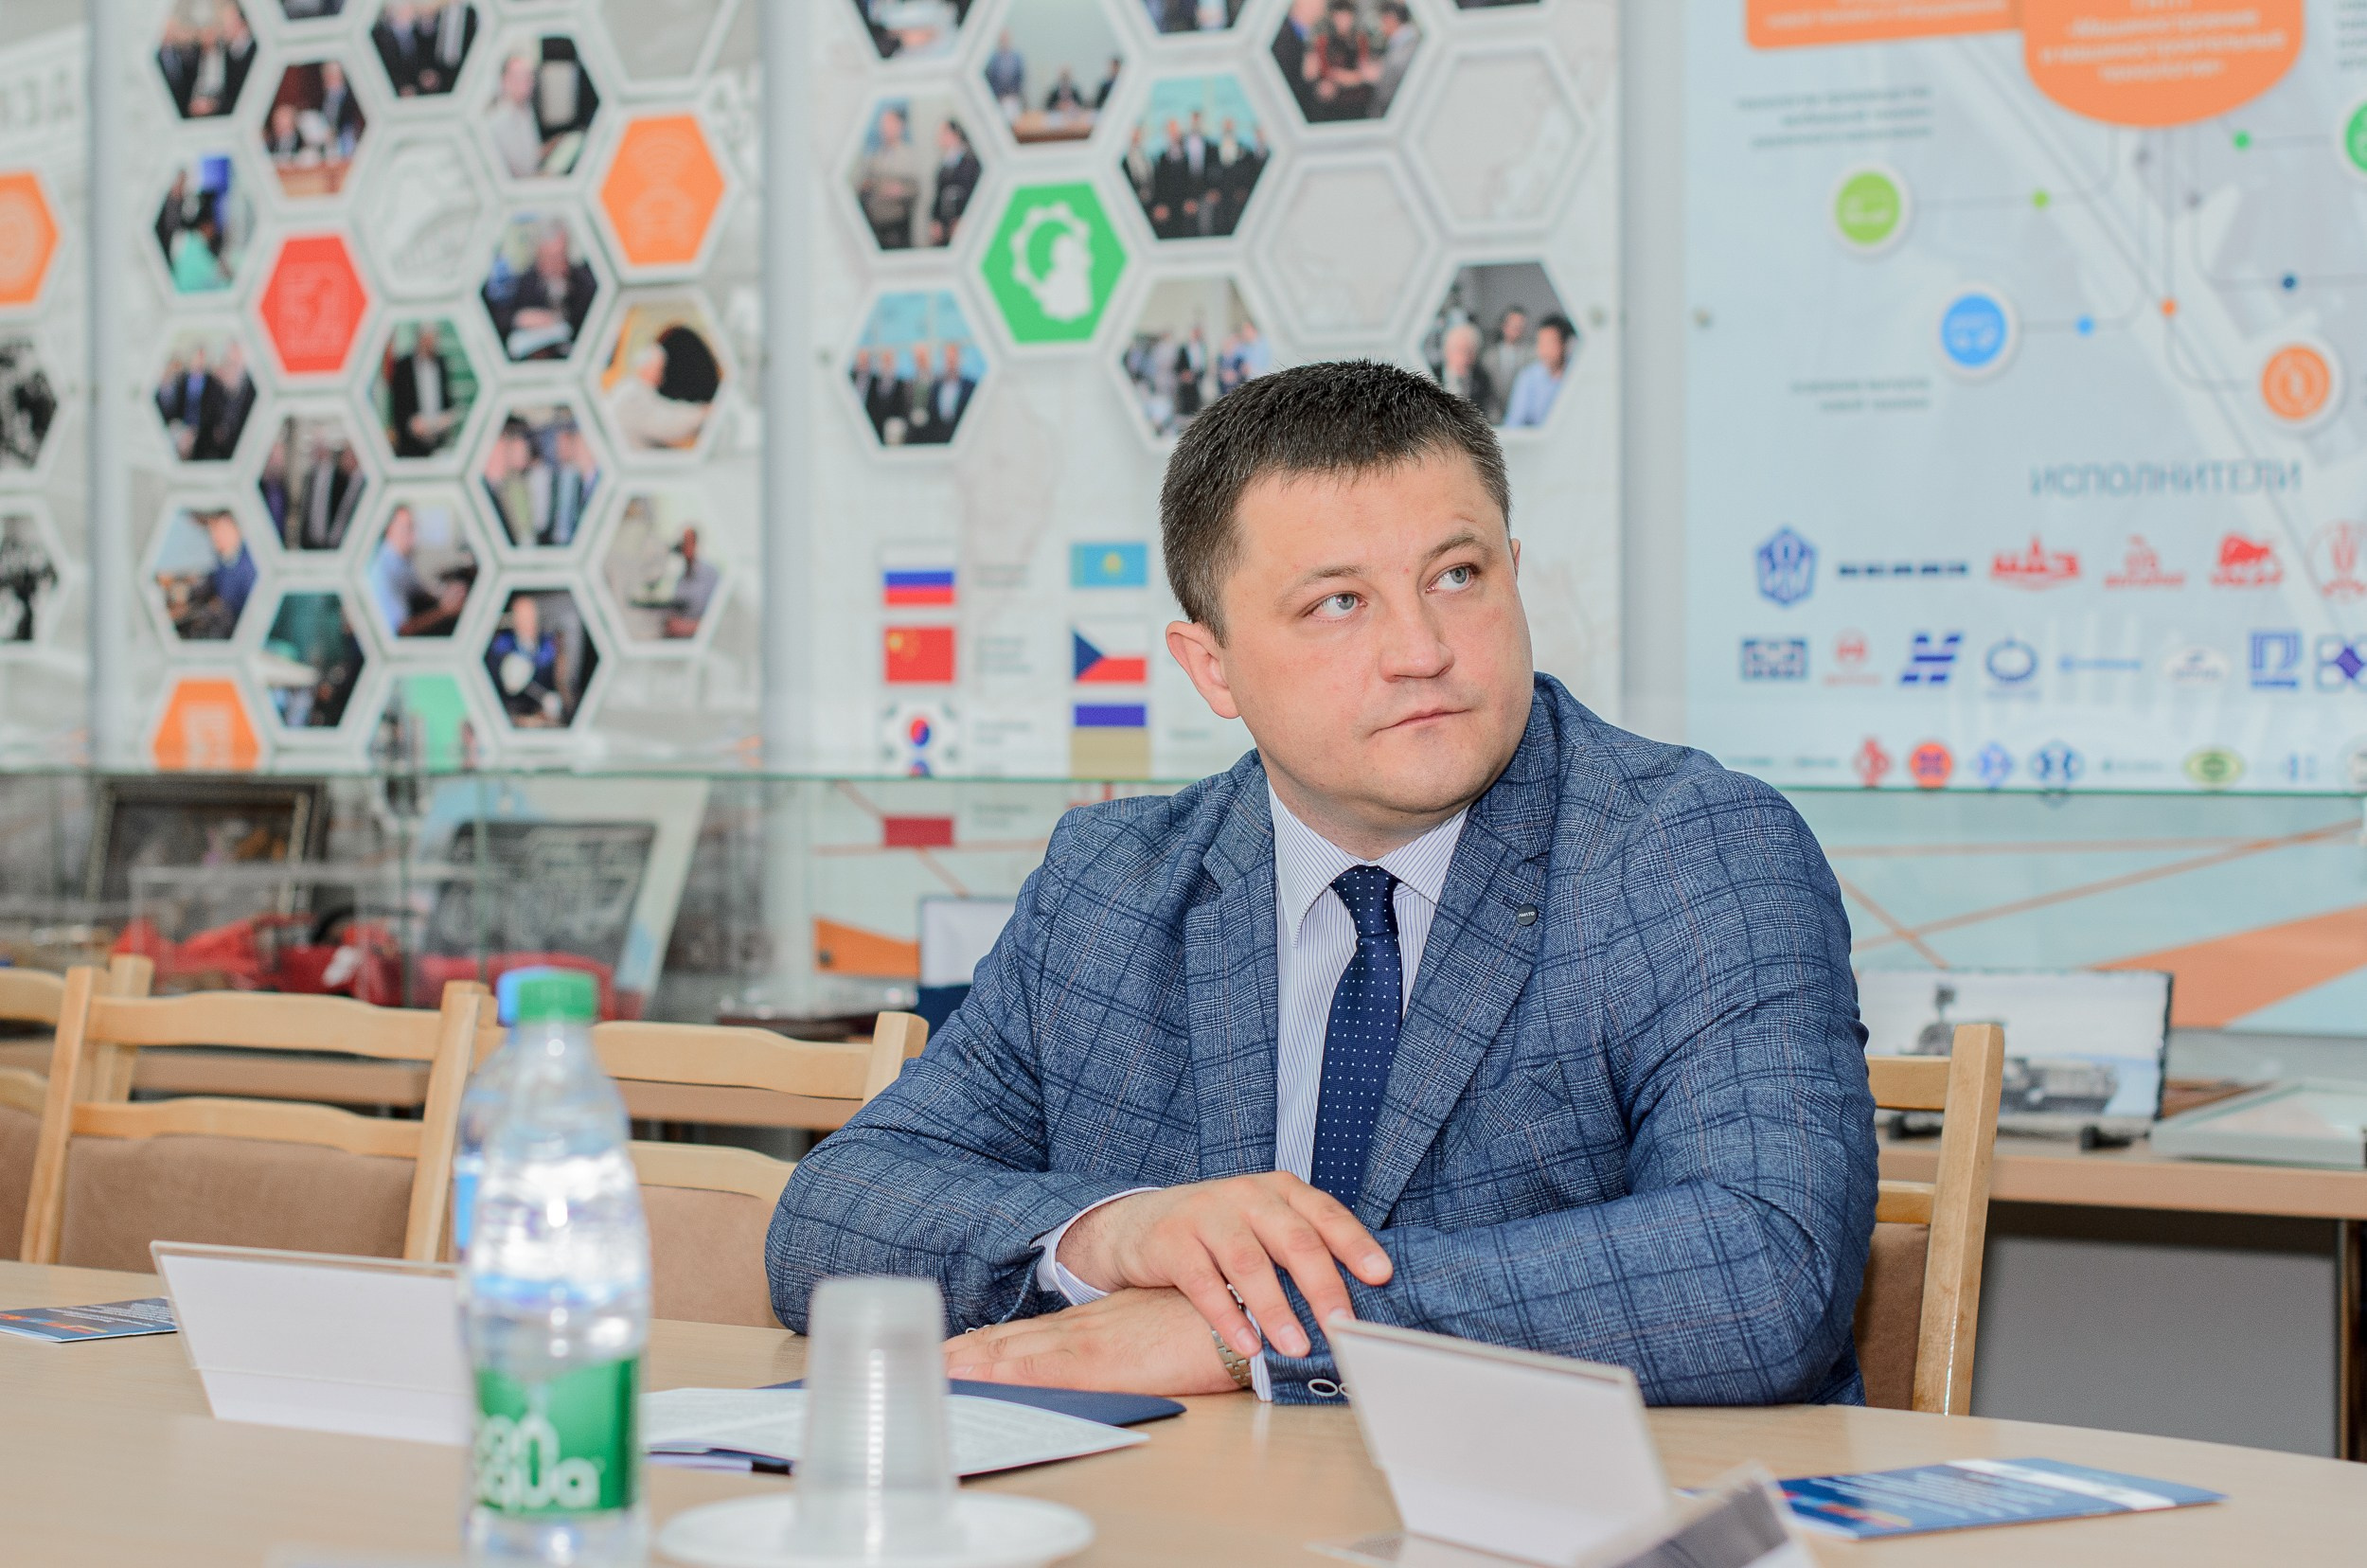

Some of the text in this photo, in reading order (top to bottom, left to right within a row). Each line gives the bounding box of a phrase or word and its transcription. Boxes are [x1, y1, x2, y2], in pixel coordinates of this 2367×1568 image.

[2029, 459, 2302, 497] ИСПОЛНИТЕЛИ
[476, 1414, 560, 1464] on
[476, 1456, 600, 1512] qua
